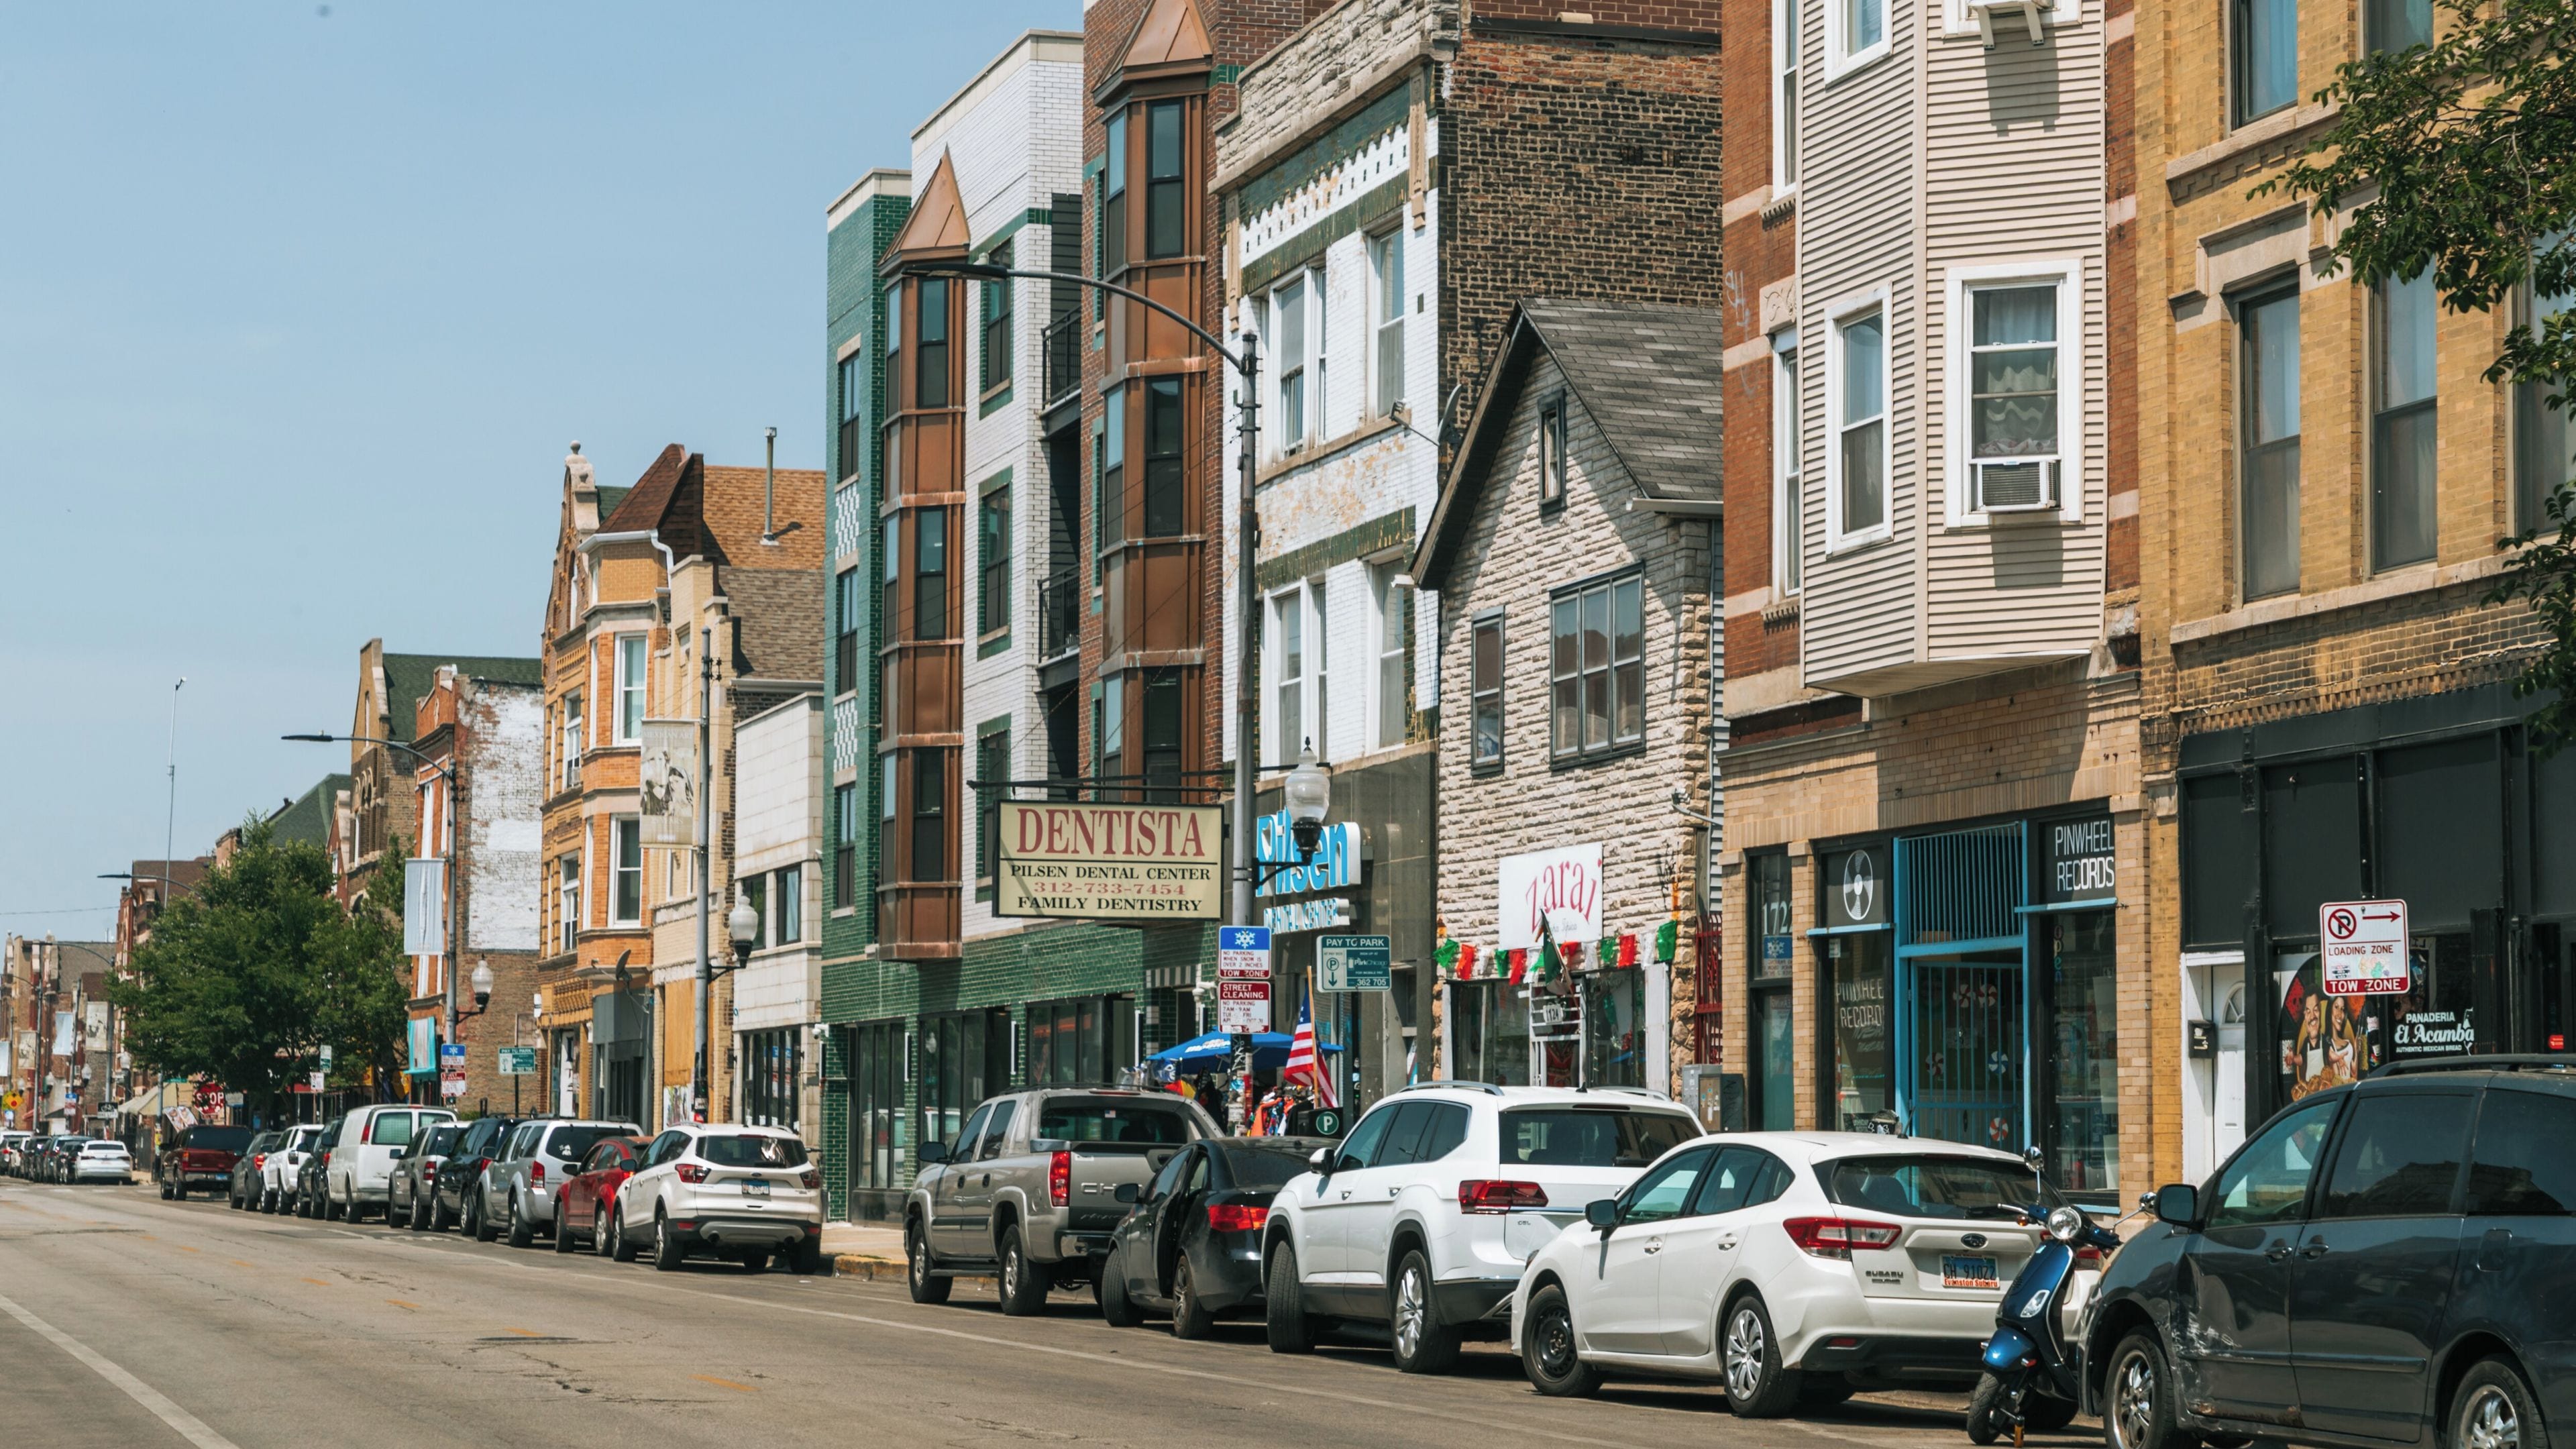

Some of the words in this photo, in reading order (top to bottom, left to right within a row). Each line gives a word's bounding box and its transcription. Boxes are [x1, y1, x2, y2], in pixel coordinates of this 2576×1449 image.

[1016, 808, 1205, 857] DENTISTA
[2055, 820, 2114, 857] PINWHEEL
[1011, 865, 1067, 878] PILSEN
[1075, 866, 1139, 879] DENTAL
[1146, 868, 1211, 881] CENTER
[2057, 856, 2114, 892] RECORDS
[1034, 882, 1185, 895] 312-733-7454
[1018, 897, 1088, 910] FAMILY
[1097, 898, 1202, 912] DENTISTRY
[1326, 938, 1343, 947] PAY
[1345, 938, 1358, 947] TO
[1360, 938, 1384, 947] PARK
[2328, 946, 2366, 956] LOADING
[2371, 945, 2394, 954] ZONE
[1837, 979, 1884, 1002] PINWHEE
[2330, 980, 2358, 992] TOW
[2365, 979, 2401, 991] ZONE
[2406, 1012, 2455, 1024] PANADERIA
[2394, 1024, 2410, 1044] El
[197, 1091, 224, 1105] SOP
[1943, 1264, 1956, 1279] CH
[1964, 1265, 1996, 1280] 91022
[1944, 1278, 1974, 1286] Evanston
[1974, 1279, 1998, 1287] Subaru
